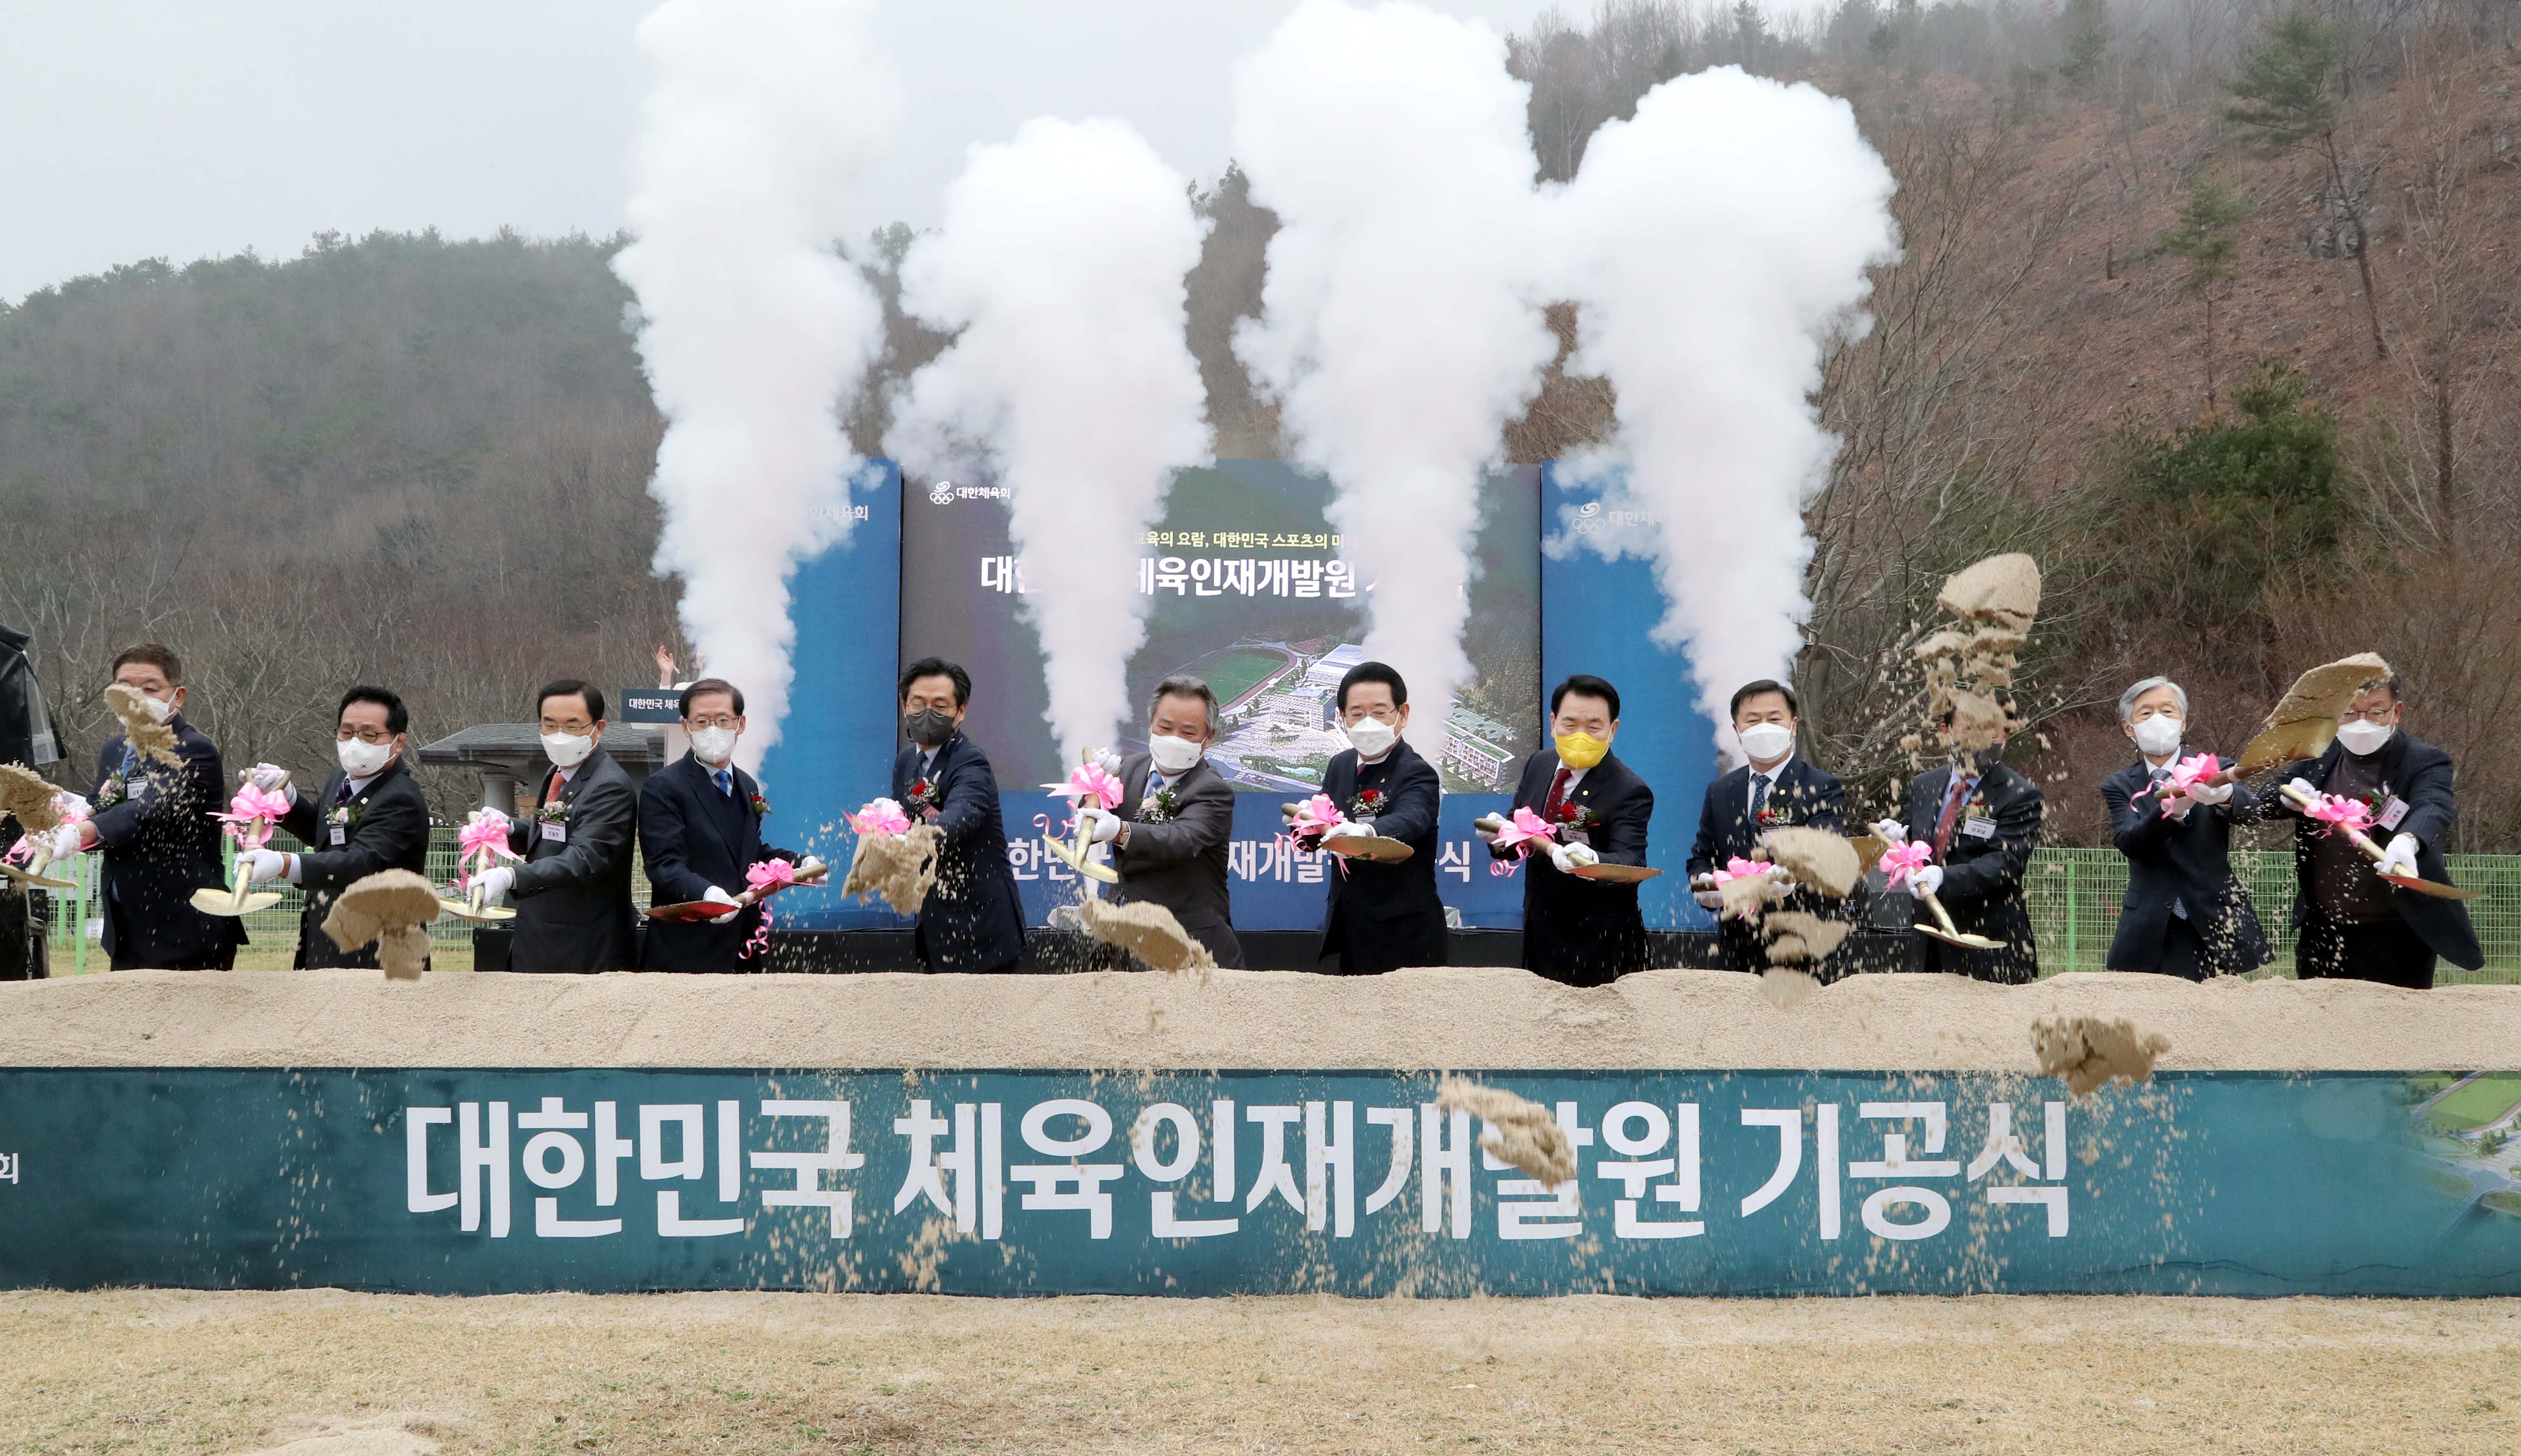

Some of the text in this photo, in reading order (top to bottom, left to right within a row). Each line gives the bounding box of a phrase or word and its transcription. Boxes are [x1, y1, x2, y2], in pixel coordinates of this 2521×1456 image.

[956, 486, 1011, 499] 대한체육회
[808, 505, 869, 521] 한체육회
[1176, 531, 1209, 548] 요람,
[1213, 531, 1269, 548] 대한민국
[1271, 533, 1327, 549] 스포츠의
[629, 698, 663, 710] 대한민국
[406, 1096, 2069, 1240] 대한민국 체육인재개발원 기공식
